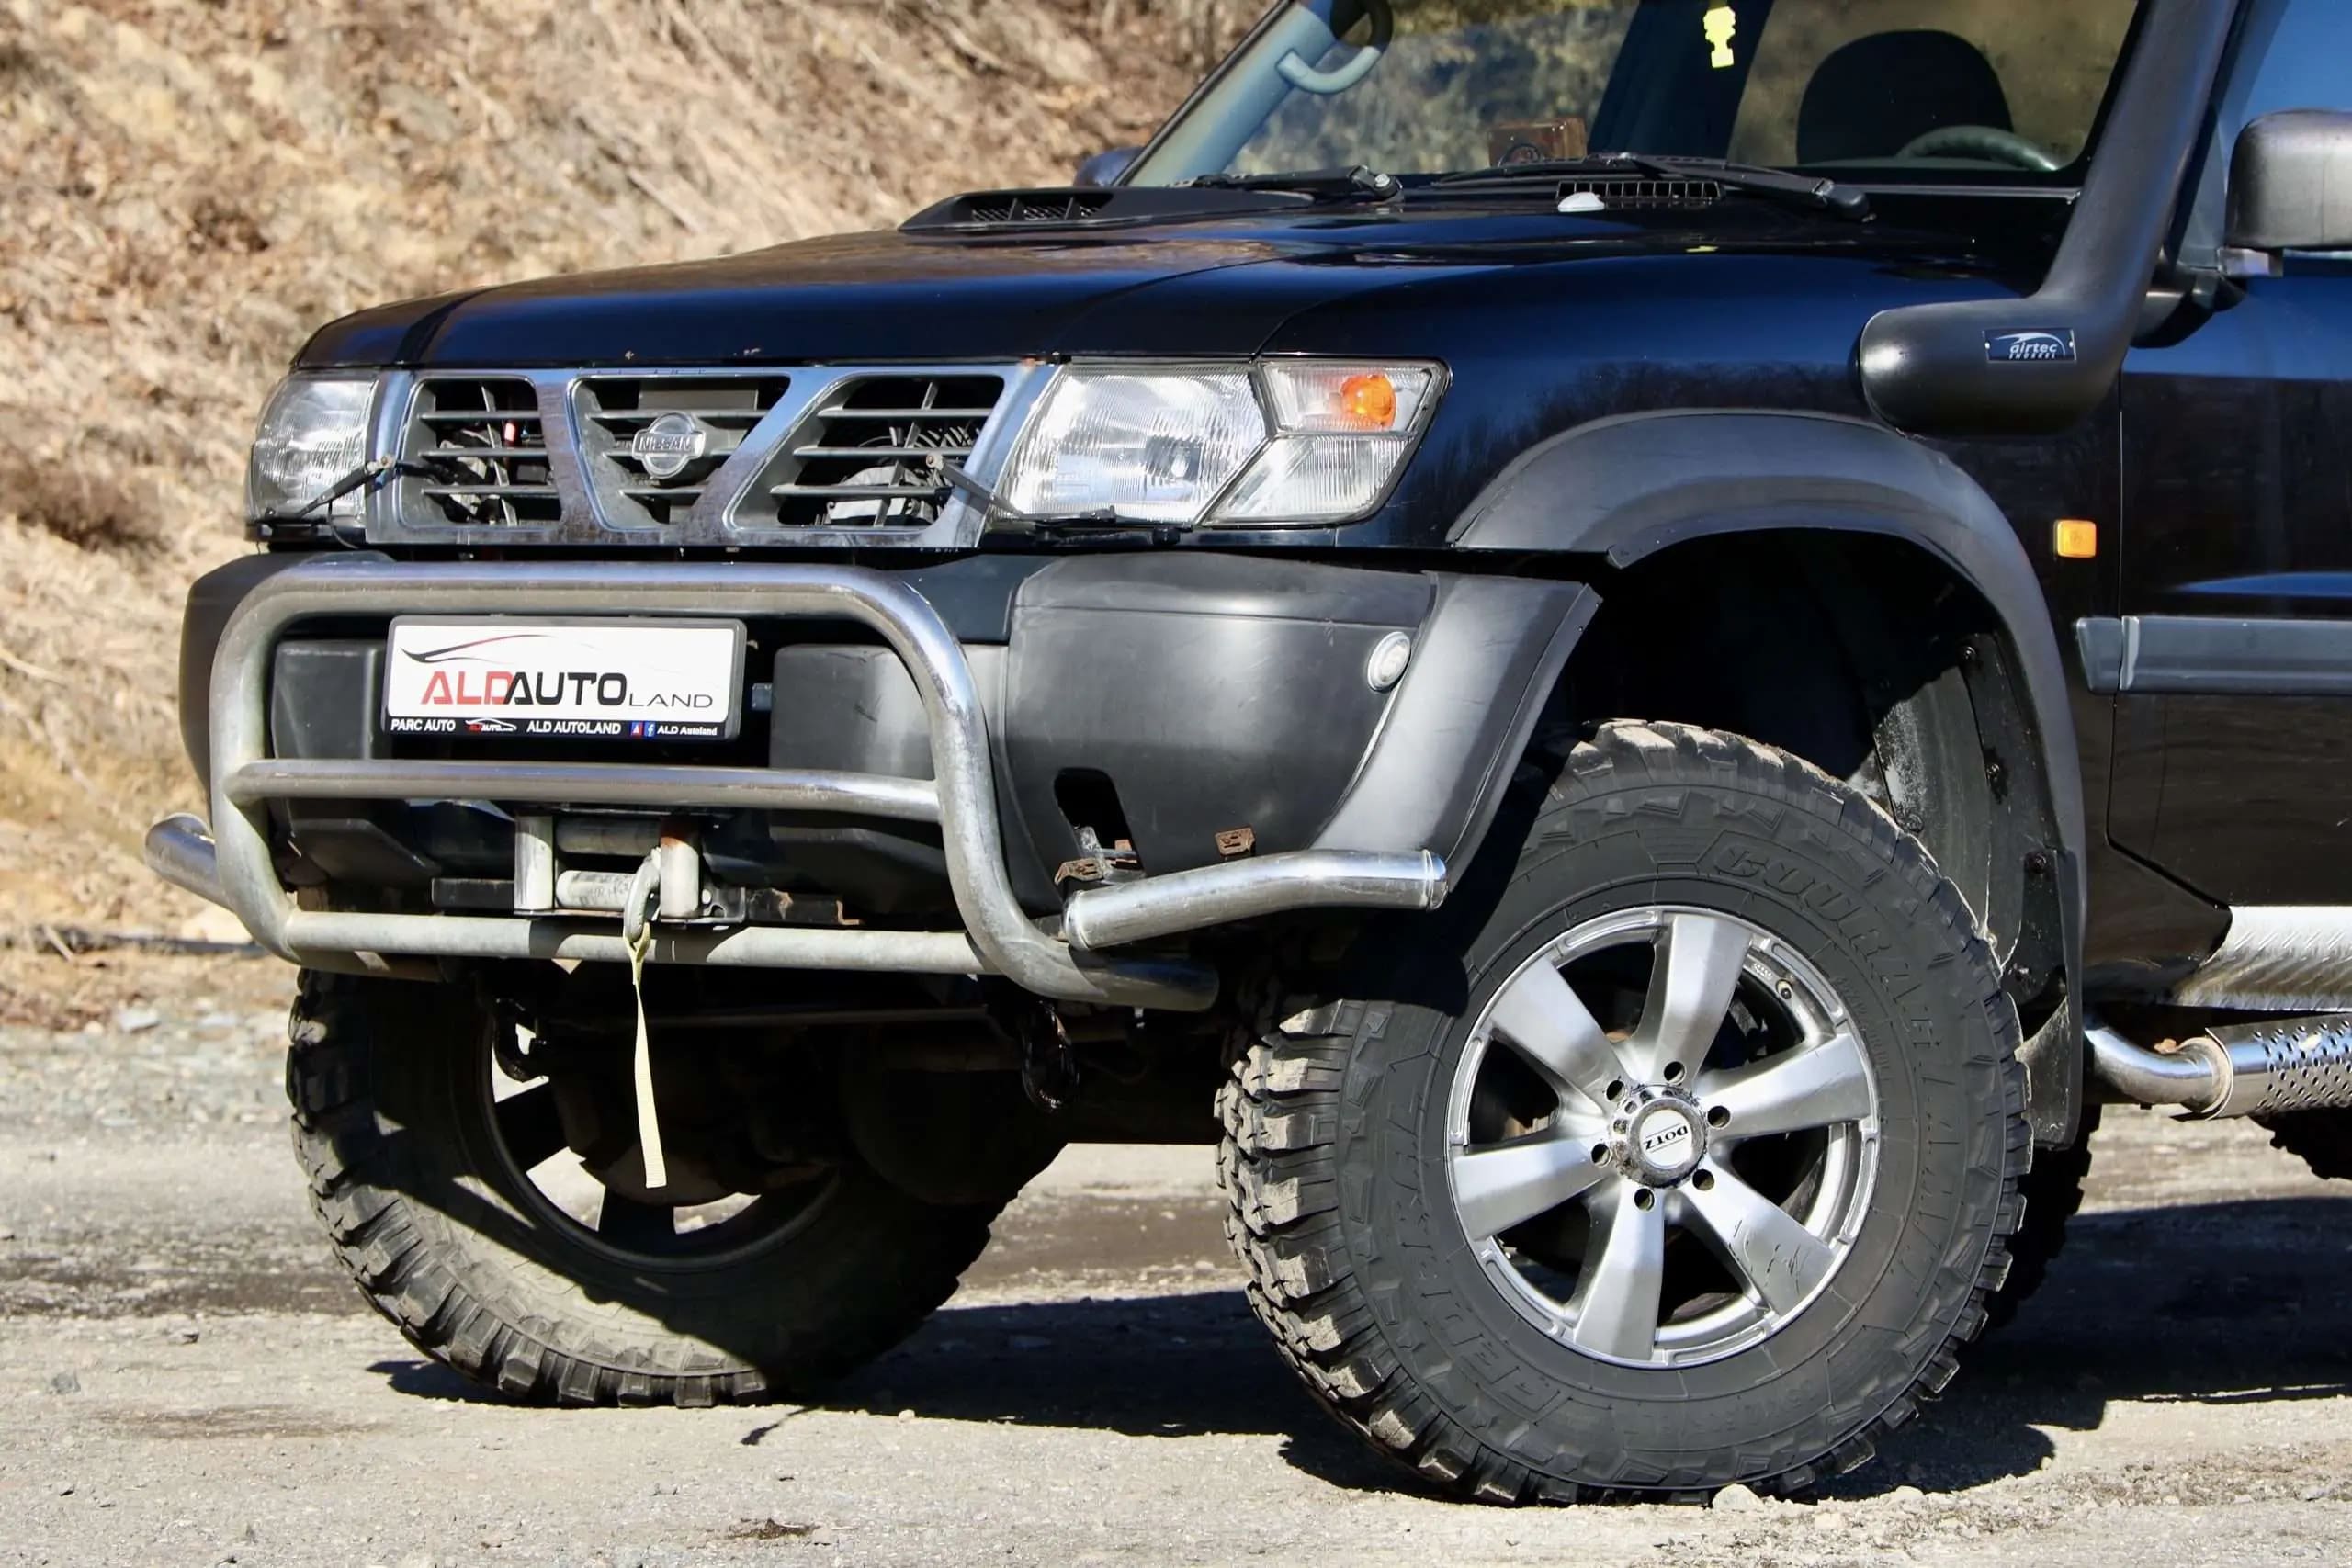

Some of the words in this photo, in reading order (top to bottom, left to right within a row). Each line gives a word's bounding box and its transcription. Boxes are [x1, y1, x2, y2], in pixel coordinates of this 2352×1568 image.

[2010, 342, 2058, 354] airtec
[639, 435, 691, 451] NISSAN
[390, 718, 423, 732] PARC
[424, 718, 456, 733] AUTO
[526, 720, 552, 734] ALD
[553, 721, 621, 735] AUTOLAND
[657, 725, 679, 735] ALD
[680, 726, 718, 737] Autoland
[1645, 1125, 1689, 1150] DOTZ
